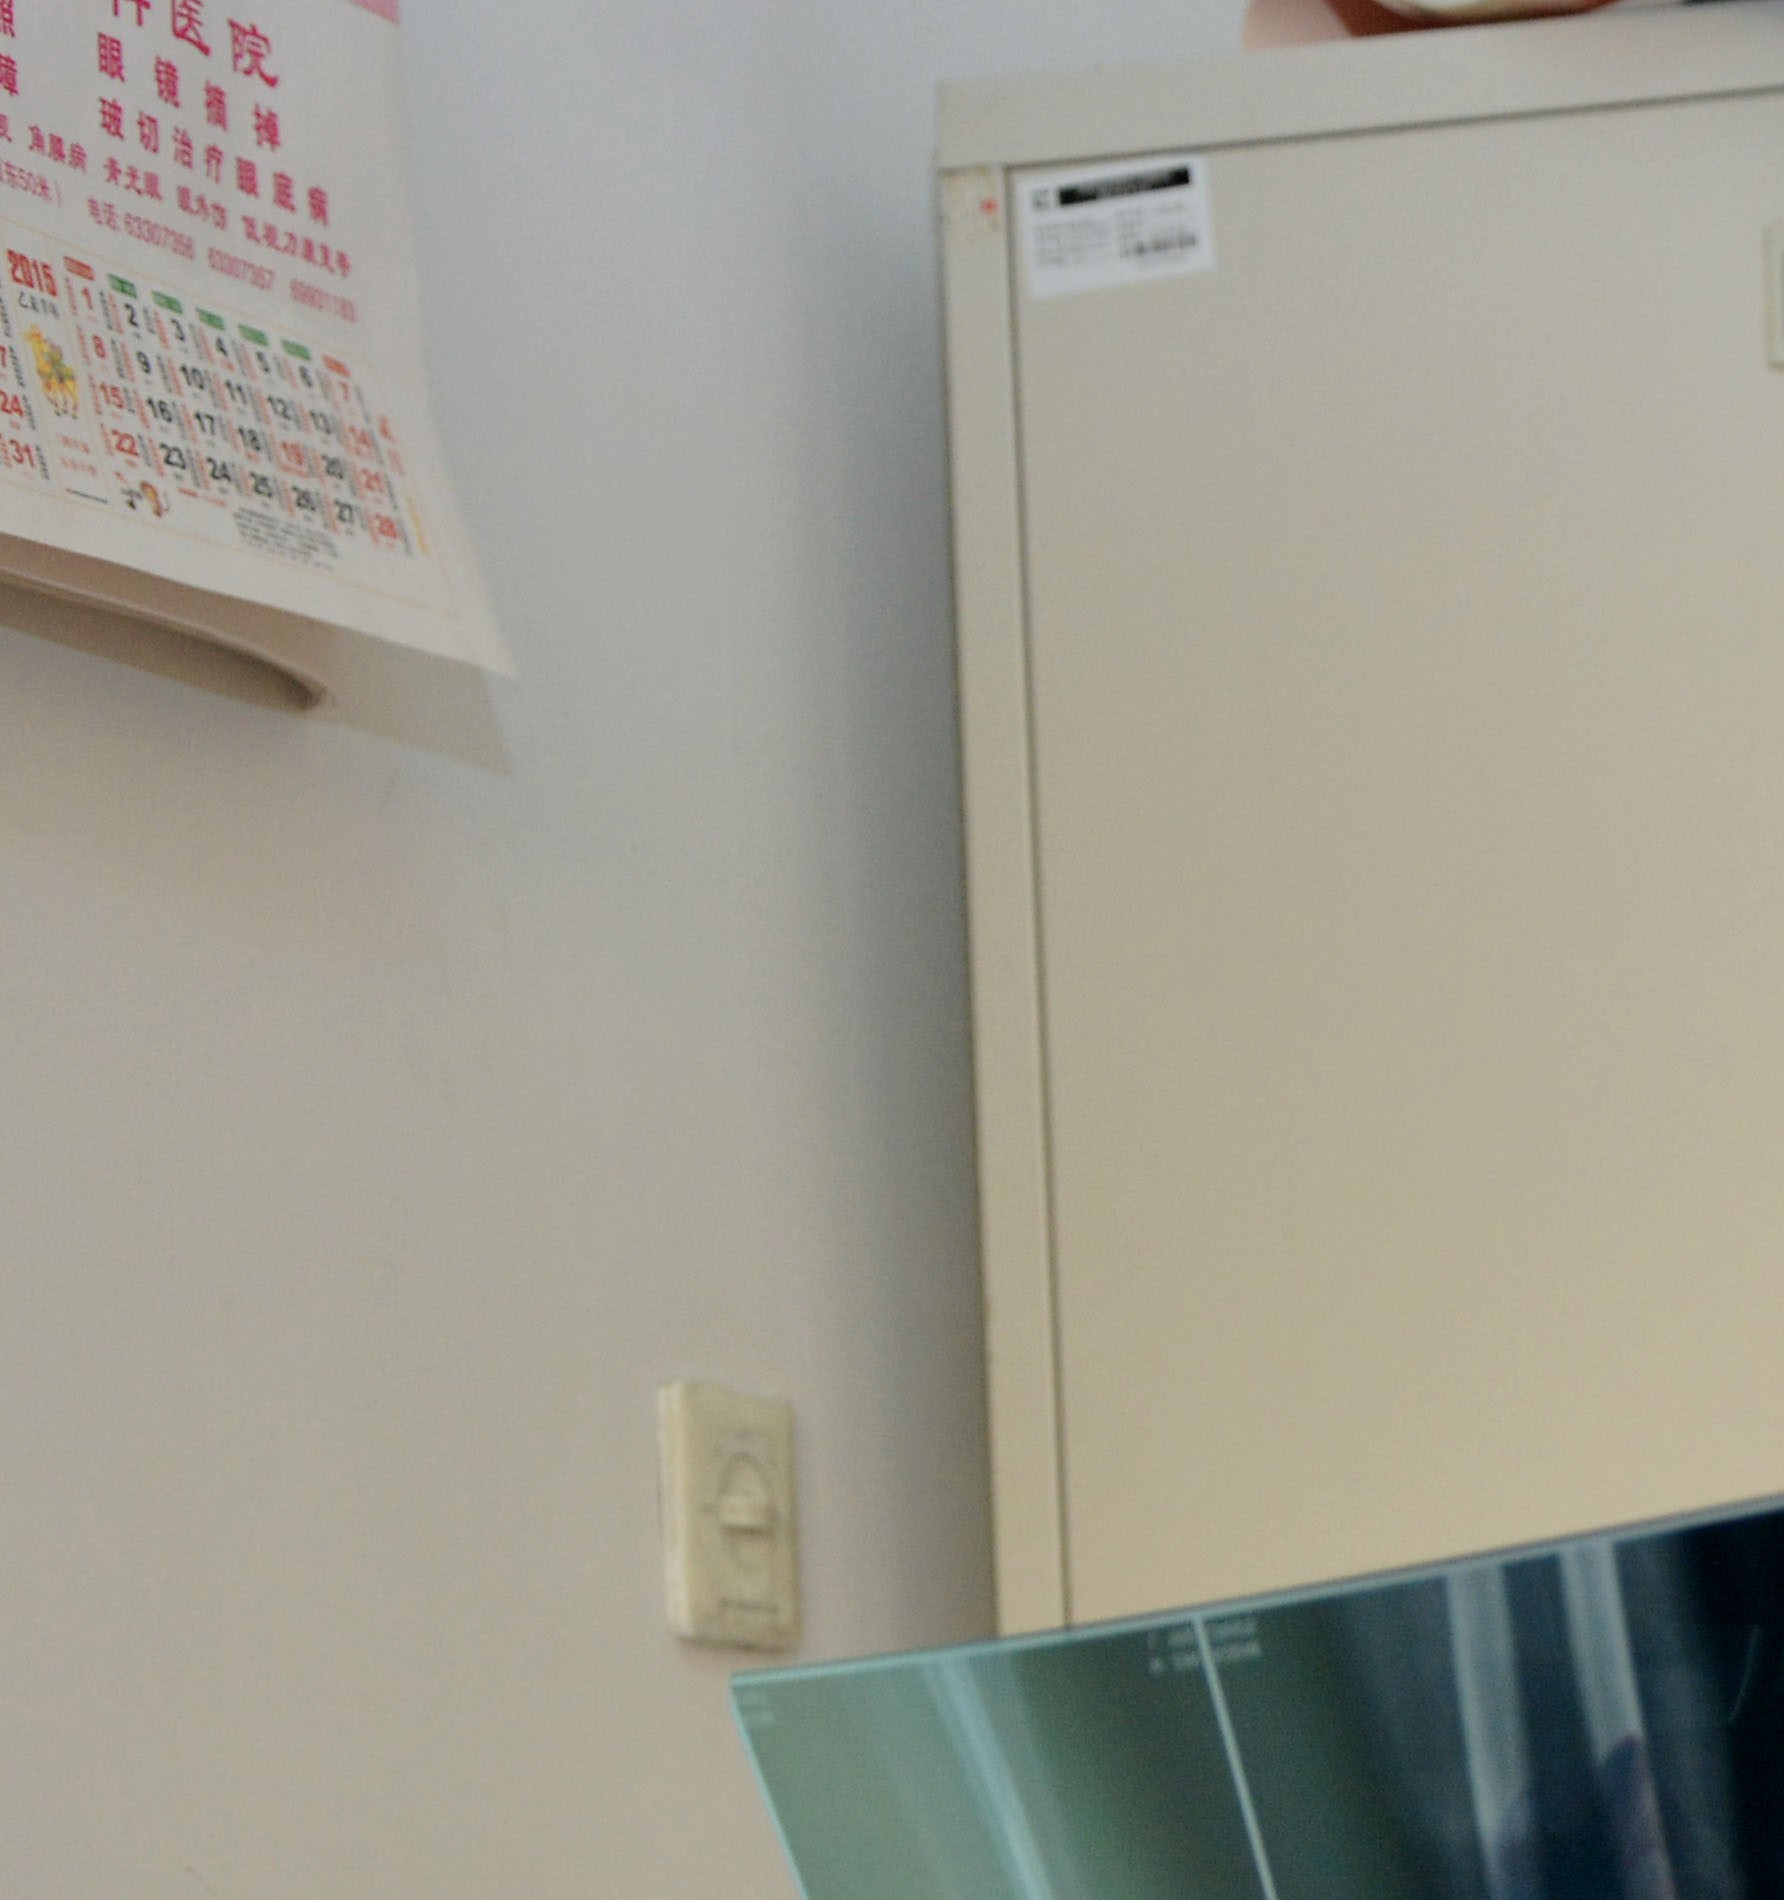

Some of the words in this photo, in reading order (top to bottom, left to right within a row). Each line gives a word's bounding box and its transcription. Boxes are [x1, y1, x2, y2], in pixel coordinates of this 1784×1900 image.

[7, 248, 57, 297] 2015
[82, 287, 93, 310] 1
[124, 303, 138, 327] 2
[0, 389, 24, 417] 24
[99, 383, 124, 409] 15
[146, 398, 172, 423] 16
[195, 412, 215, 435] 17
[136, 351, 150, 373] 9
[180, 364, 204, 389] 10
[225, 380, 247, 405] 11
[268, 395, 291, 420] 12
[9, 438, 36, 469] 31
[111, 429, 139, 457] 22
[207, 456, 231, 482] 24
